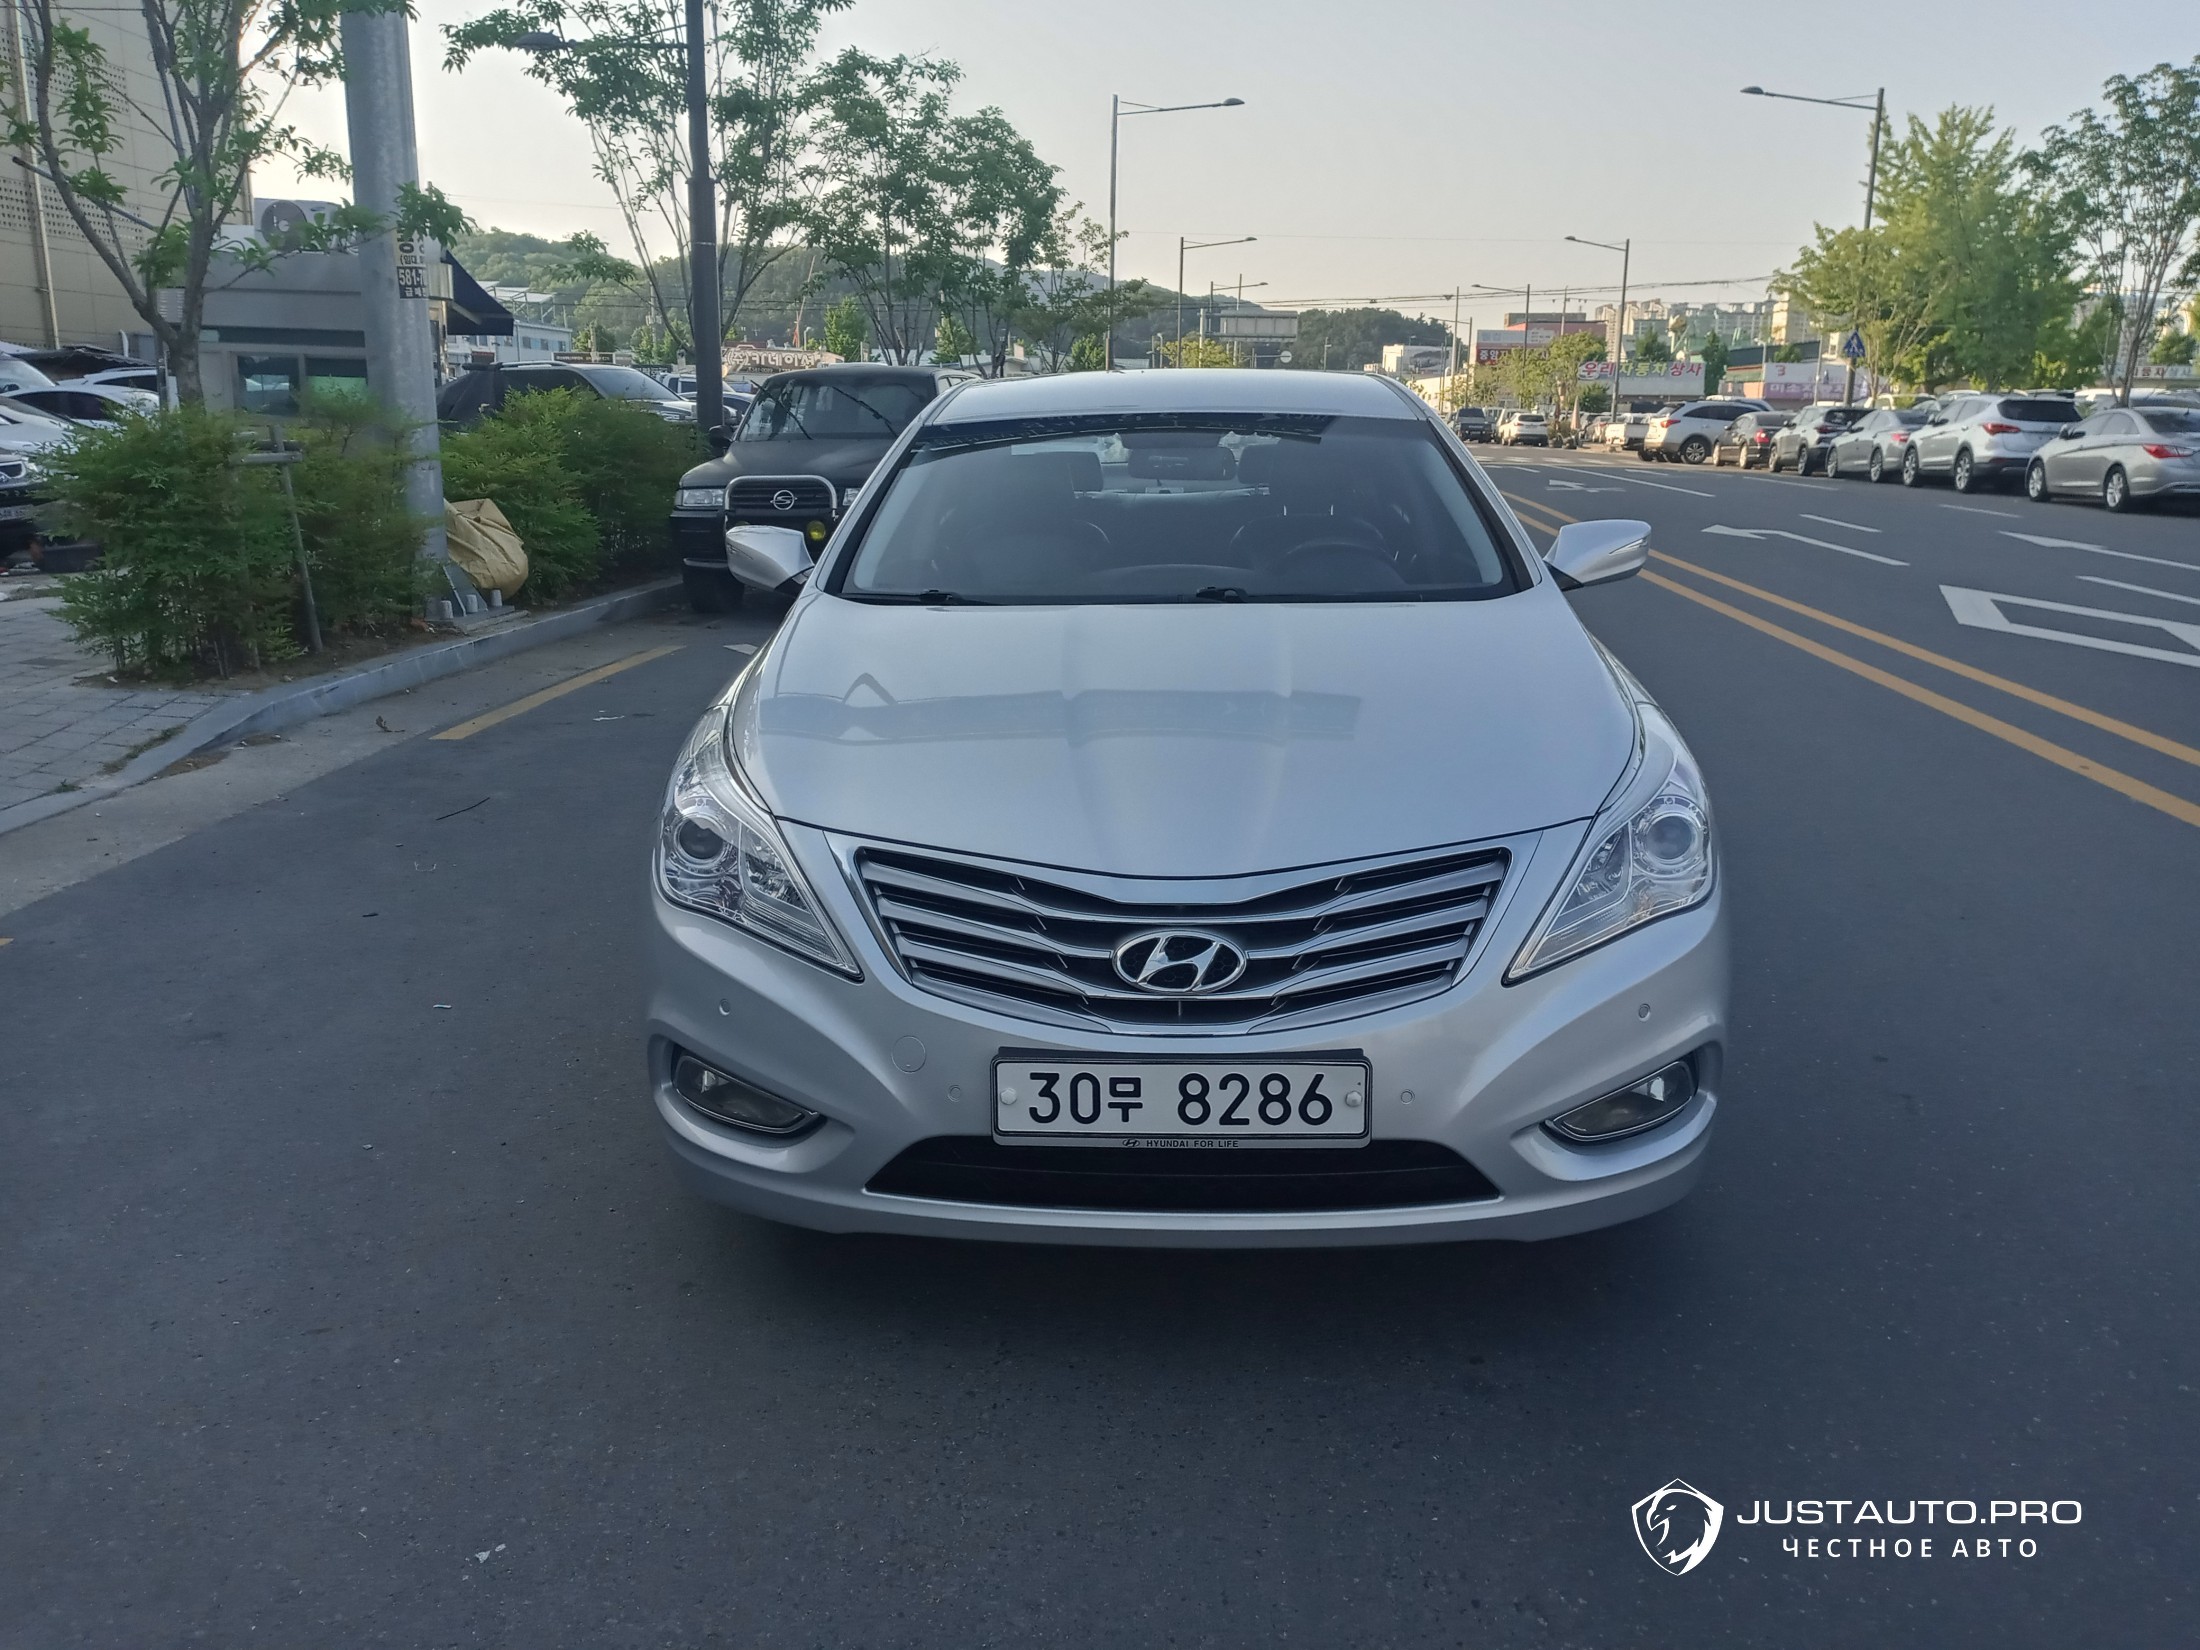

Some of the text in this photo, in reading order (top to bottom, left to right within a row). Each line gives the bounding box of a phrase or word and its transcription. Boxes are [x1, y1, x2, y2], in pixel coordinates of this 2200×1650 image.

[1029, 1072, 1333, 1126] 30무 8286
[1146, 1139, 1239, 1149] HYUNDAI FOR LIFE
